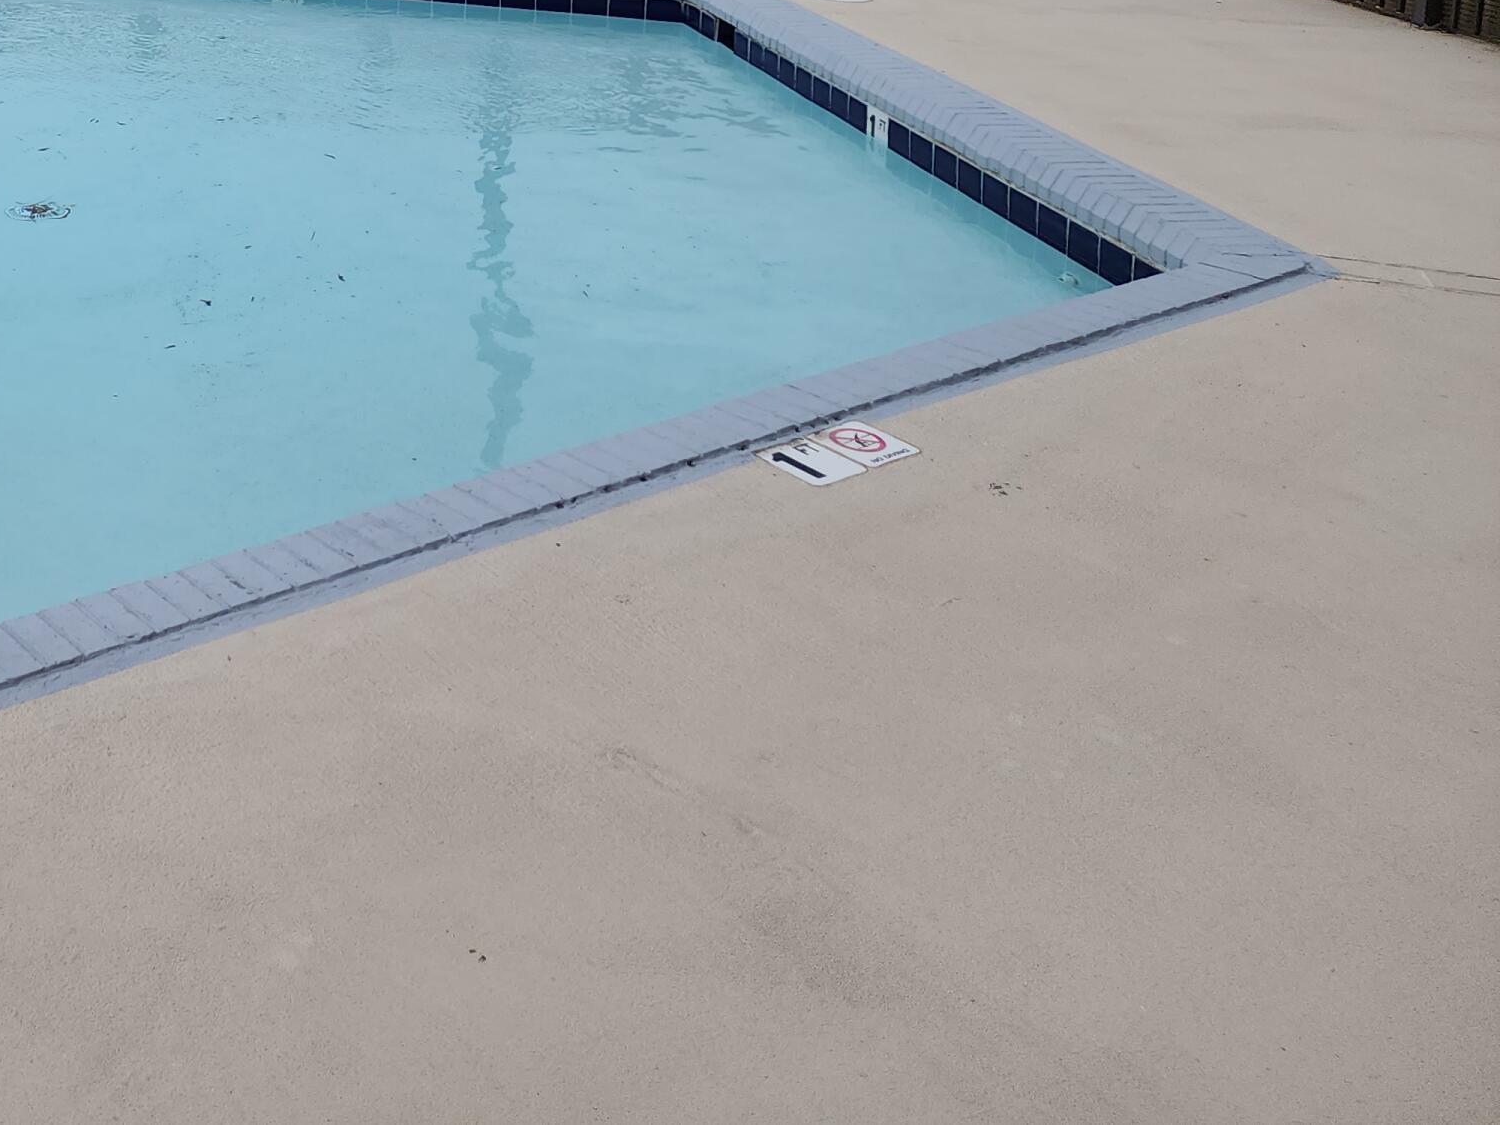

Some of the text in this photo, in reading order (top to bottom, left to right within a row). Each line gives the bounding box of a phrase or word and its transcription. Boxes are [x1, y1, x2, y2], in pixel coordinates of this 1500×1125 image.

[869, 114, 876, 138] 1
[771, 442, 828, 479] 1 FT
